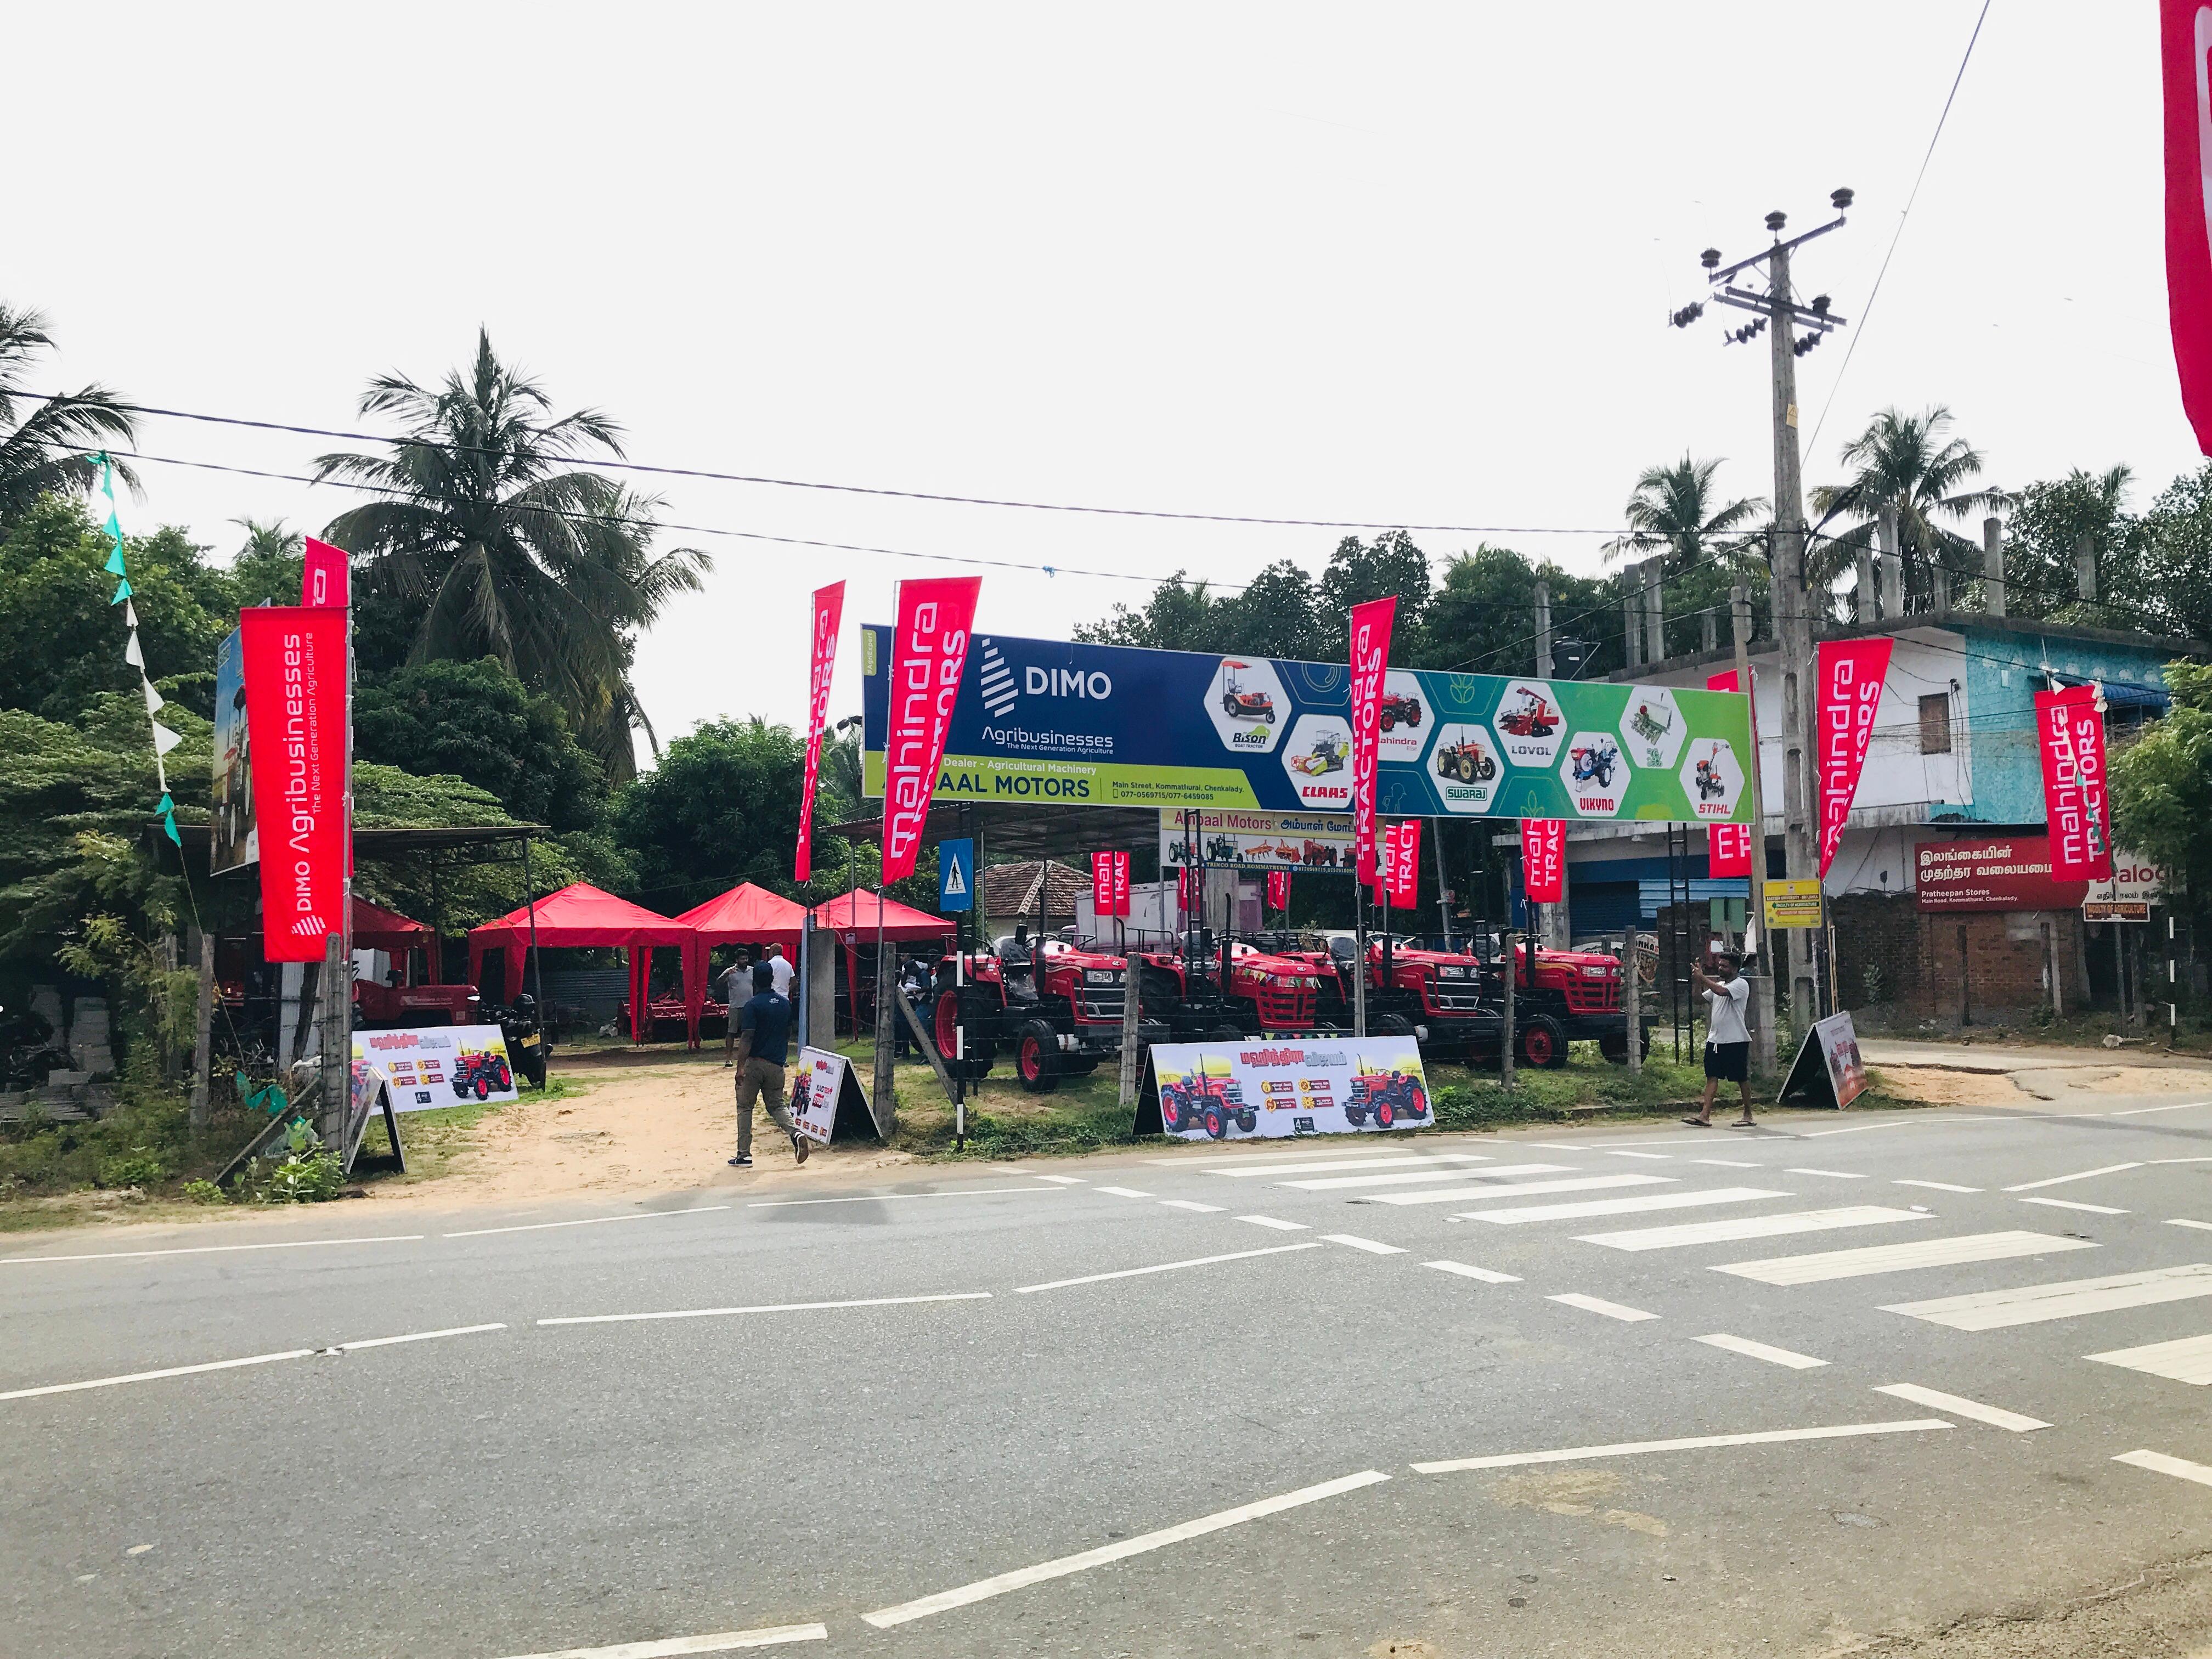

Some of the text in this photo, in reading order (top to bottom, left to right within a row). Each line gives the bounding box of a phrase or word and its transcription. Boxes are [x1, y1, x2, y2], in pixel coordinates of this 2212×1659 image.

[1026, 666, 1111, 699] DIMO
[305, 633, 322, 814] The Next Generation Agriculture
[982, 726, 1113, 747] Agribusinesses
[1232, 731, 1267, 744] Bison
[1358, 647, 1381, 860] TRACTORS
[1511, 746, 1551, 755] LOVOL
[283, 633, 315, 912] DIMO Agribusinesses
[944, 757, 977, 768] Dealer
[988, 760, 1045, 772] Agricultural
[1048, 764, 1097, 776] Machinery
[996, 775, 1090, 797] MOTORS
[1302, 786, 1348, 798] CLAAS
[1699, 803, 1730, 814] STIHL
[1227, 815, 1272, 830] Motors
[1399, 821, 1414, 894] TRACT
[1545, 820, 1559, 887] TRAC
[1920, 845, 2012, 866] இலங்கையின்
[1114, 851, 1125, 900] TRAC
[1921, 890, 1963, 898] Pratheepan
